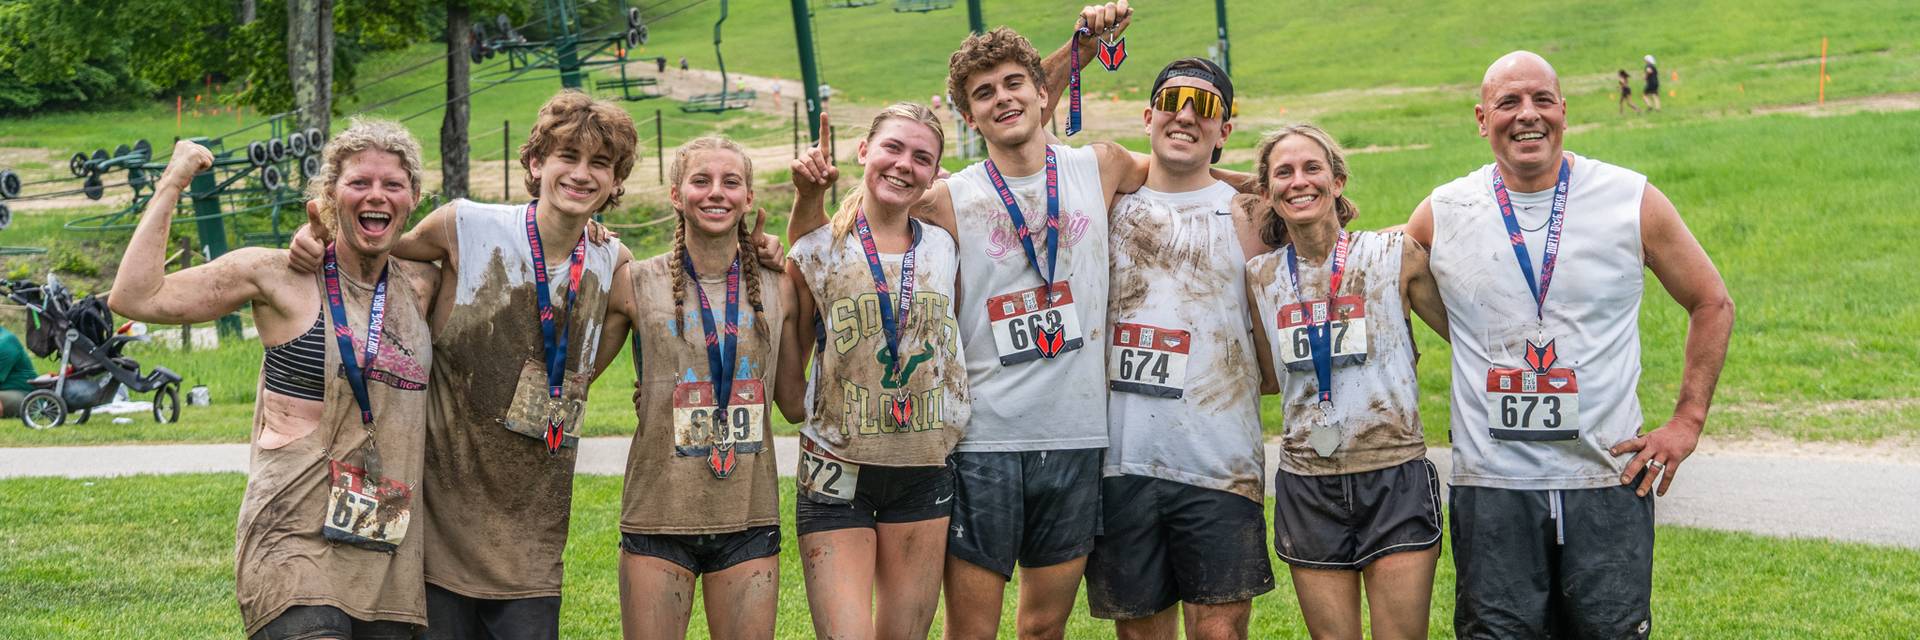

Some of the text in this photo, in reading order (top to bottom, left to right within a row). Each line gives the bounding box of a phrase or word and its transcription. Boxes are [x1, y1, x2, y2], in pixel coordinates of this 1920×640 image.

[1546, 234, 1560, 255] DIRTY
[1554, 194, 1566, 212] DASH
[900, 290, 912, 310] DIRTY
[367, 330, 380, 355] DIRTY
[1293, 323, 1349, 359] 67
[1120, 349, 1170, 384] 674
[1501, 395, 1562, 428] 673
[800, 452, 842, 496] 672
